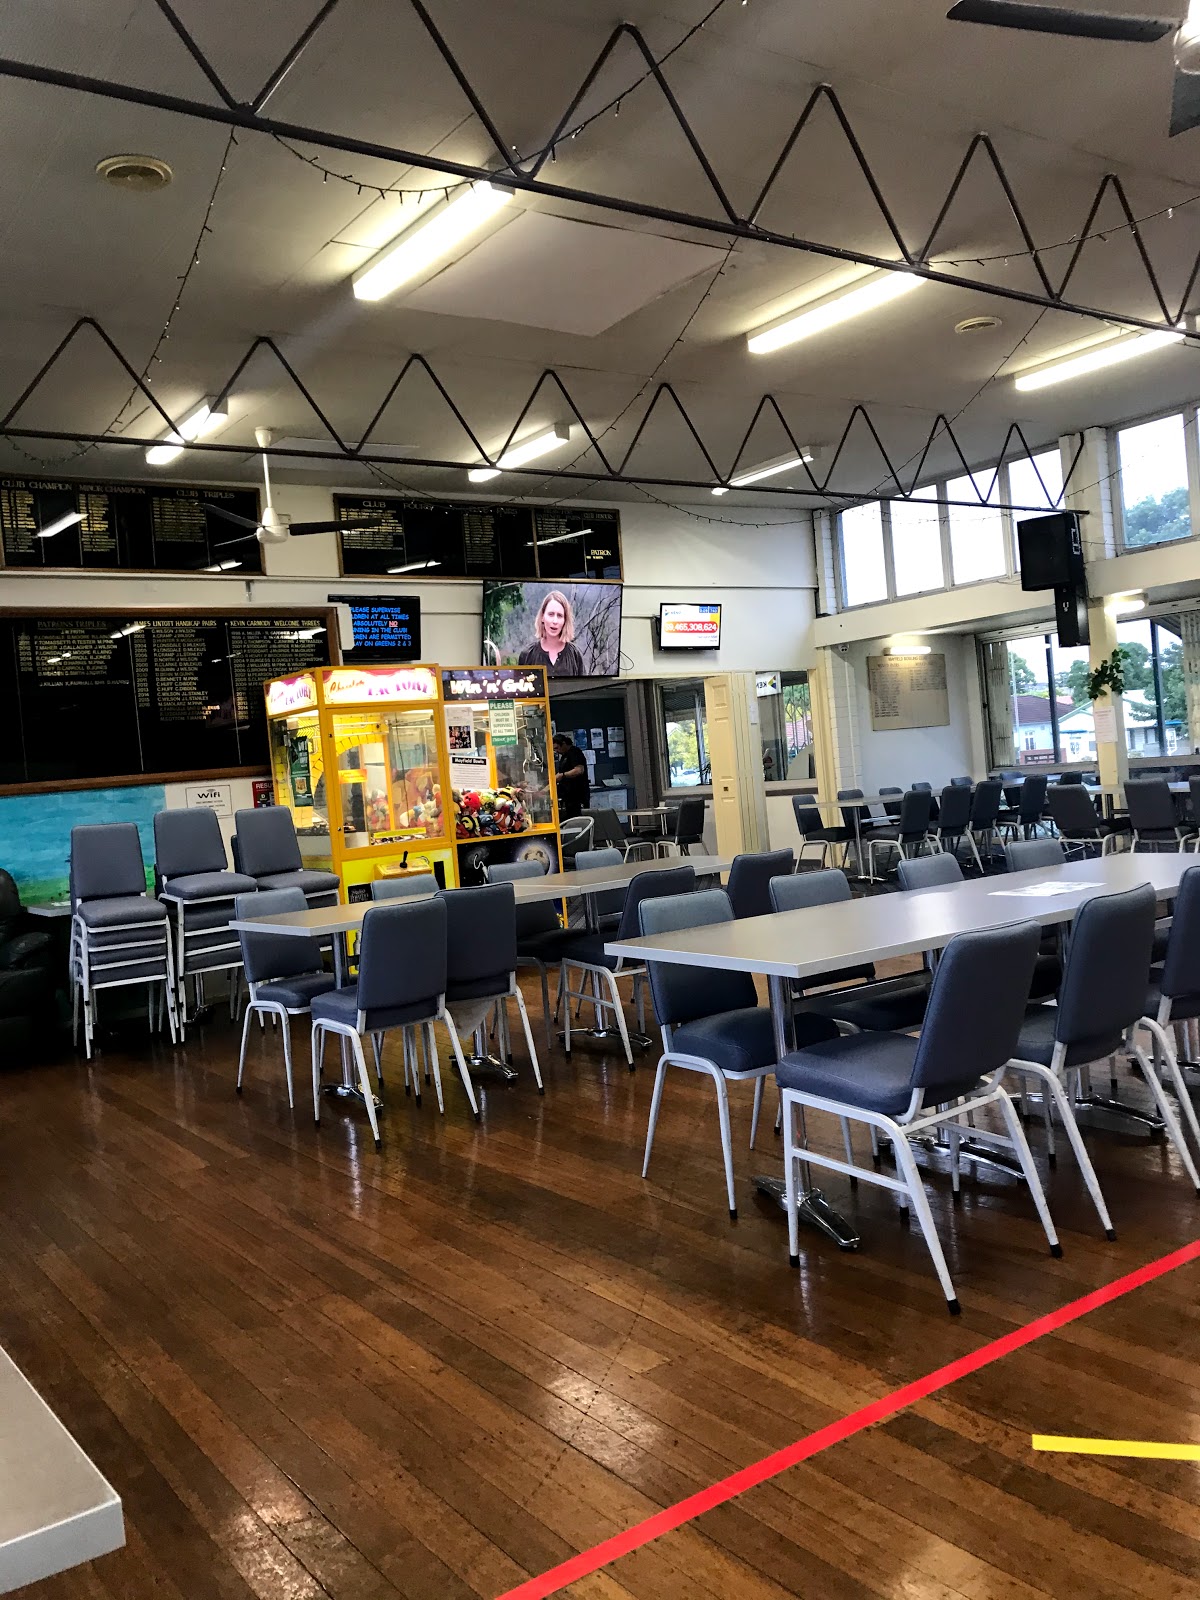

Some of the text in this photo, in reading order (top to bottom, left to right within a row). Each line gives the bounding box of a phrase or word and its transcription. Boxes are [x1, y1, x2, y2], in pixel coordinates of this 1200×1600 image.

[2, 480, 72, 491] CLUB CHAMPION
[105, 486, 146, 495] CHAMPION
[176, 489, 235, 499] CLUB TRIPLES
[75, 620, 106, 628] TRIPLES
[450, 679, 483, 695] Win
[502, 677, 536, 693] Grin
